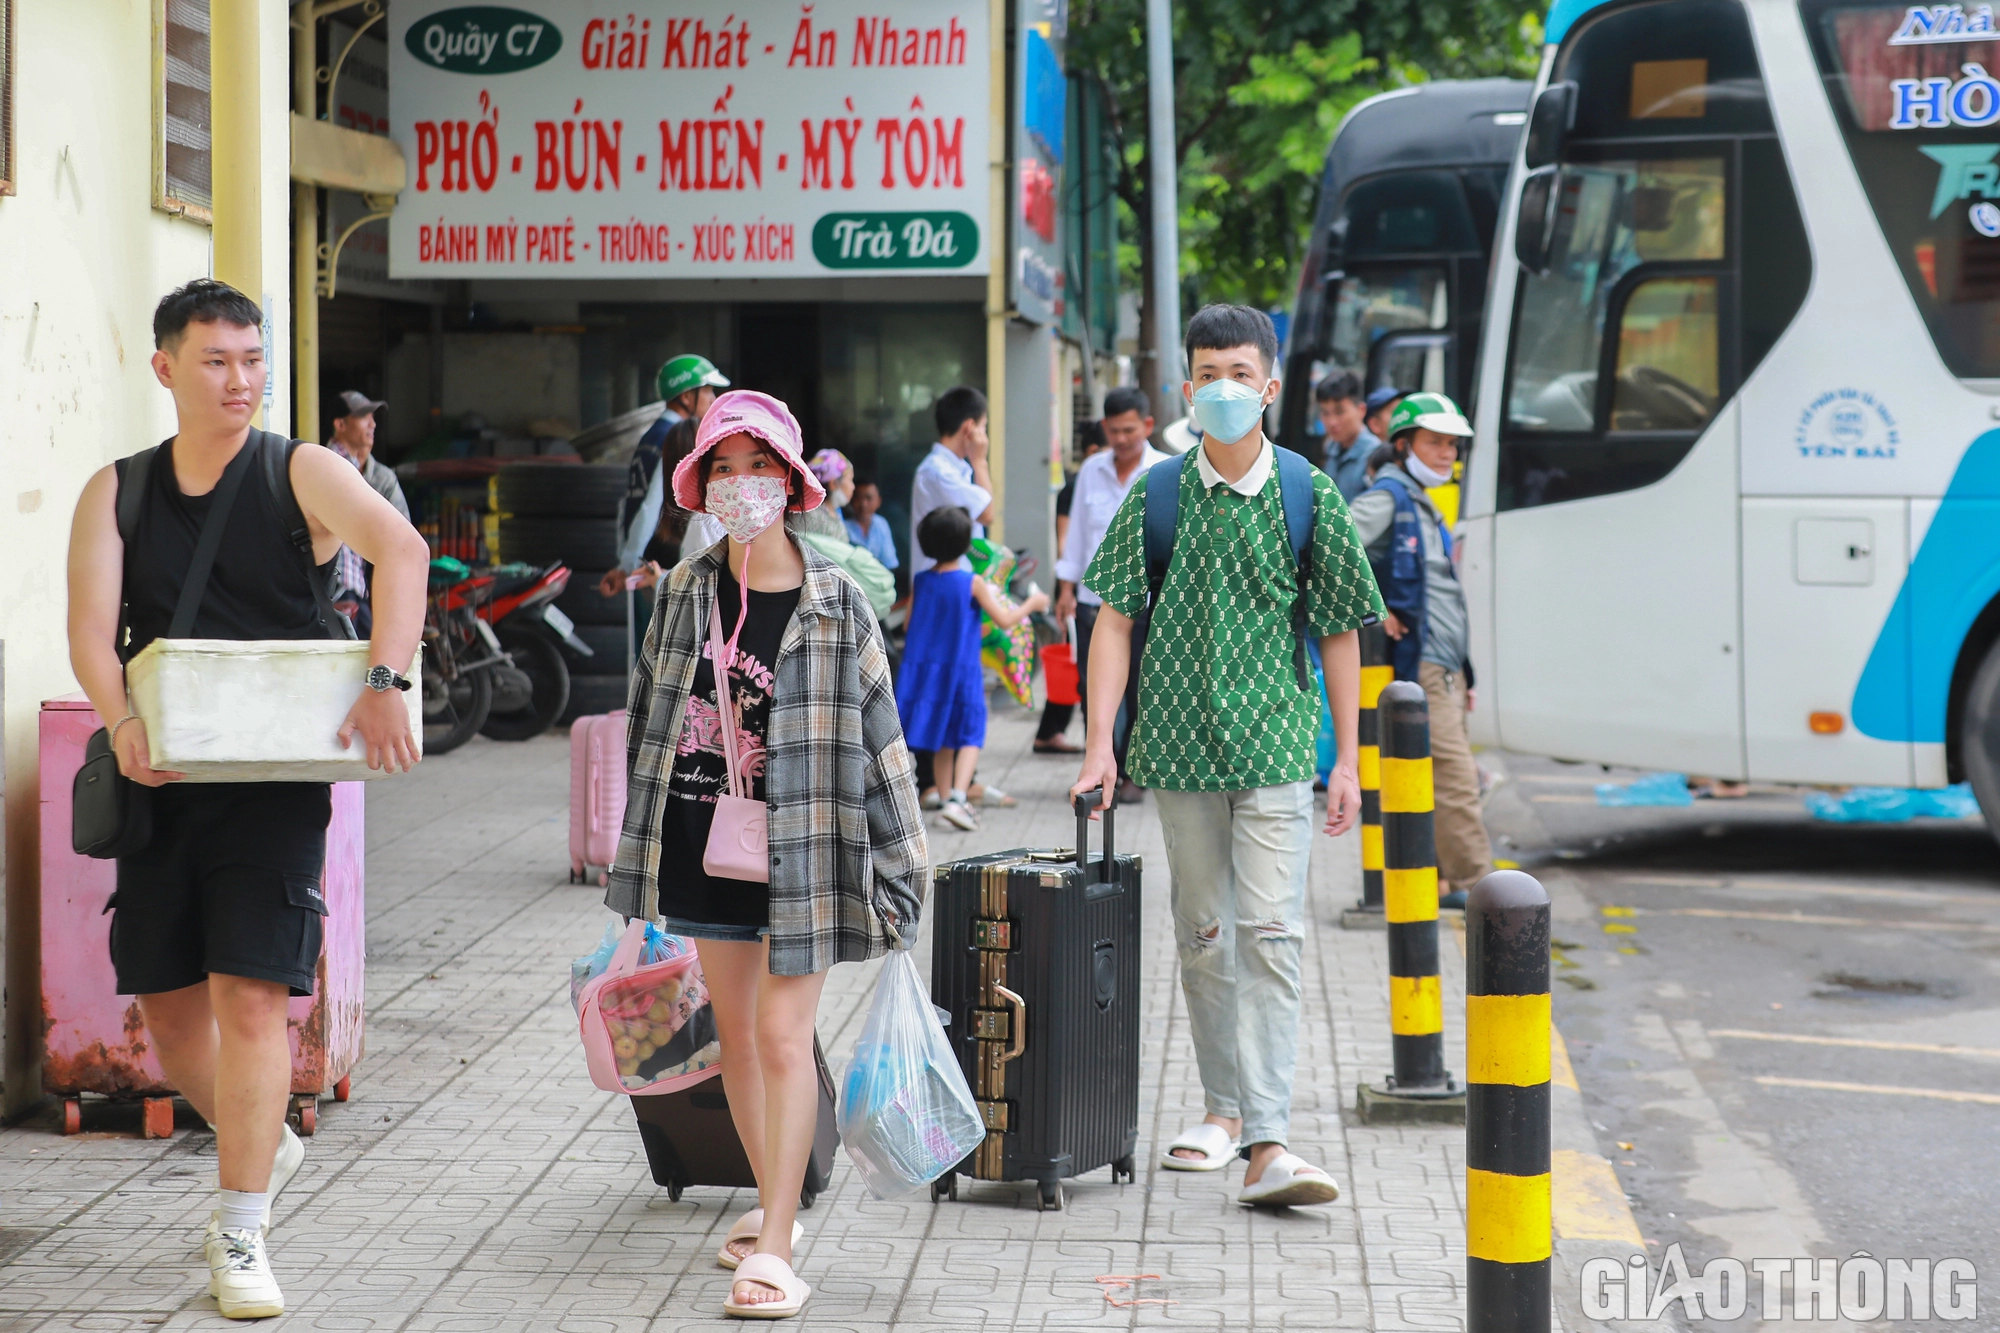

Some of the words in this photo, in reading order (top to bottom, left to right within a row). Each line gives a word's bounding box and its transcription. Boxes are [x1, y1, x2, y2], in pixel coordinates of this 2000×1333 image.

[424, 21, 499, 64] Quầy
[505, 24, 544, 57] C7
[581, 13, 652, 70] Giải
[662, 14, 750, 69] Khát
[787, 2, 837, 68] Ăn
[851, 16, 967, 67] Nhanh
[414, 88, 499, 192] PHỞ
[534, 97, 623, 192] BÚN
[658, 83, 765, 191] MIẾN
[801, 95, 864, 190] MỲ
[876, 94, 965, 189] TÔM
[1917, 143, 2000, 221] TR
[419, 215, 479, 263] BÁNH
[598, 214, 670, 263] TRỨNG
[692, 214, 736, 262] XÚC
[743, 214, 795, 262] XÍCH
[831, 218, 898, 259] Trà
[903, 218, 959, 259] Đá
